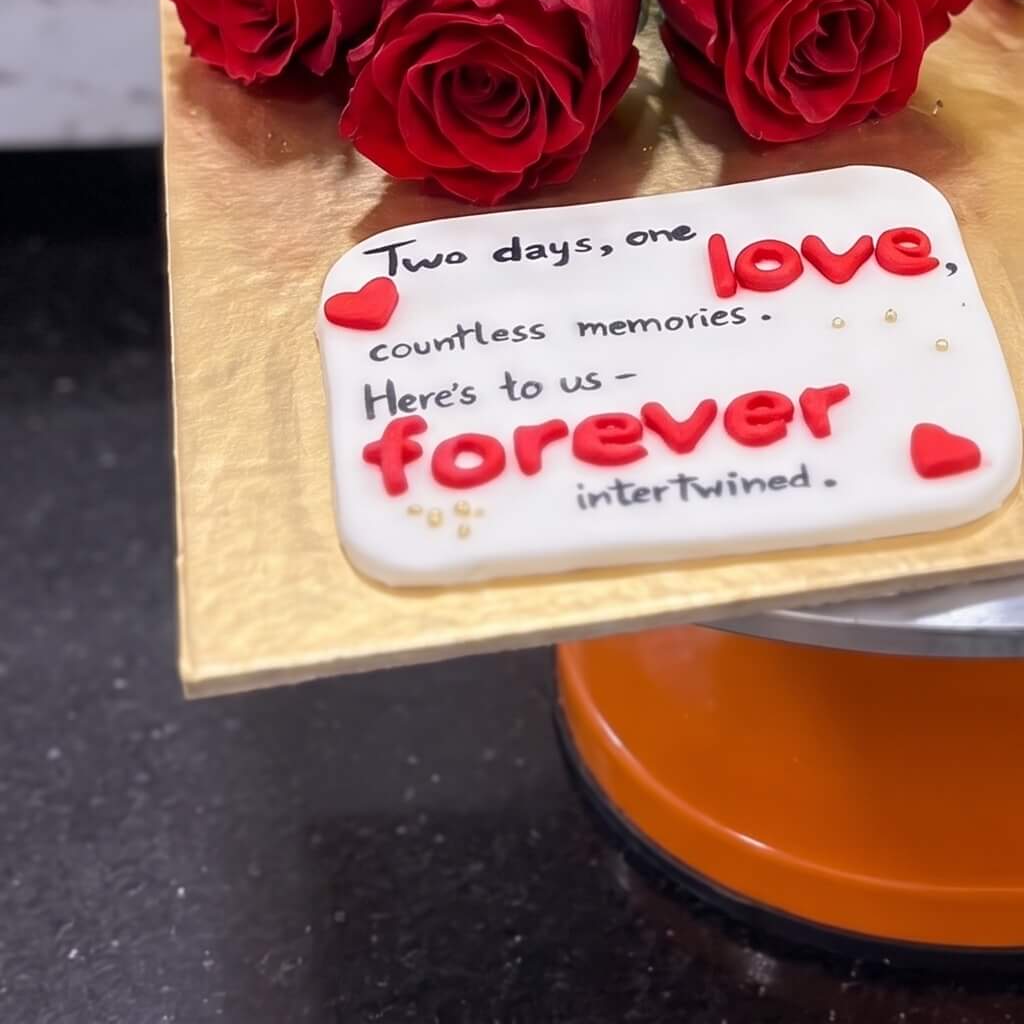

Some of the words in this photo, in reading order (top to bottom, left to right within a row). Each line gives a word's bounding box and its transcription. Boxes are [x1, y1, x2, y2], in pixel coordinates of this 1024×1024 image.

[362, 239, 468, 277] Two
[492, 236, 614, 267] days,
[625, 224, 697, 247] one
[369, 321, 546, 362] countless
[499, 371, 543, 401] to
[560, 372, 602, 393] us
[363, 385, 849, 497] forever
